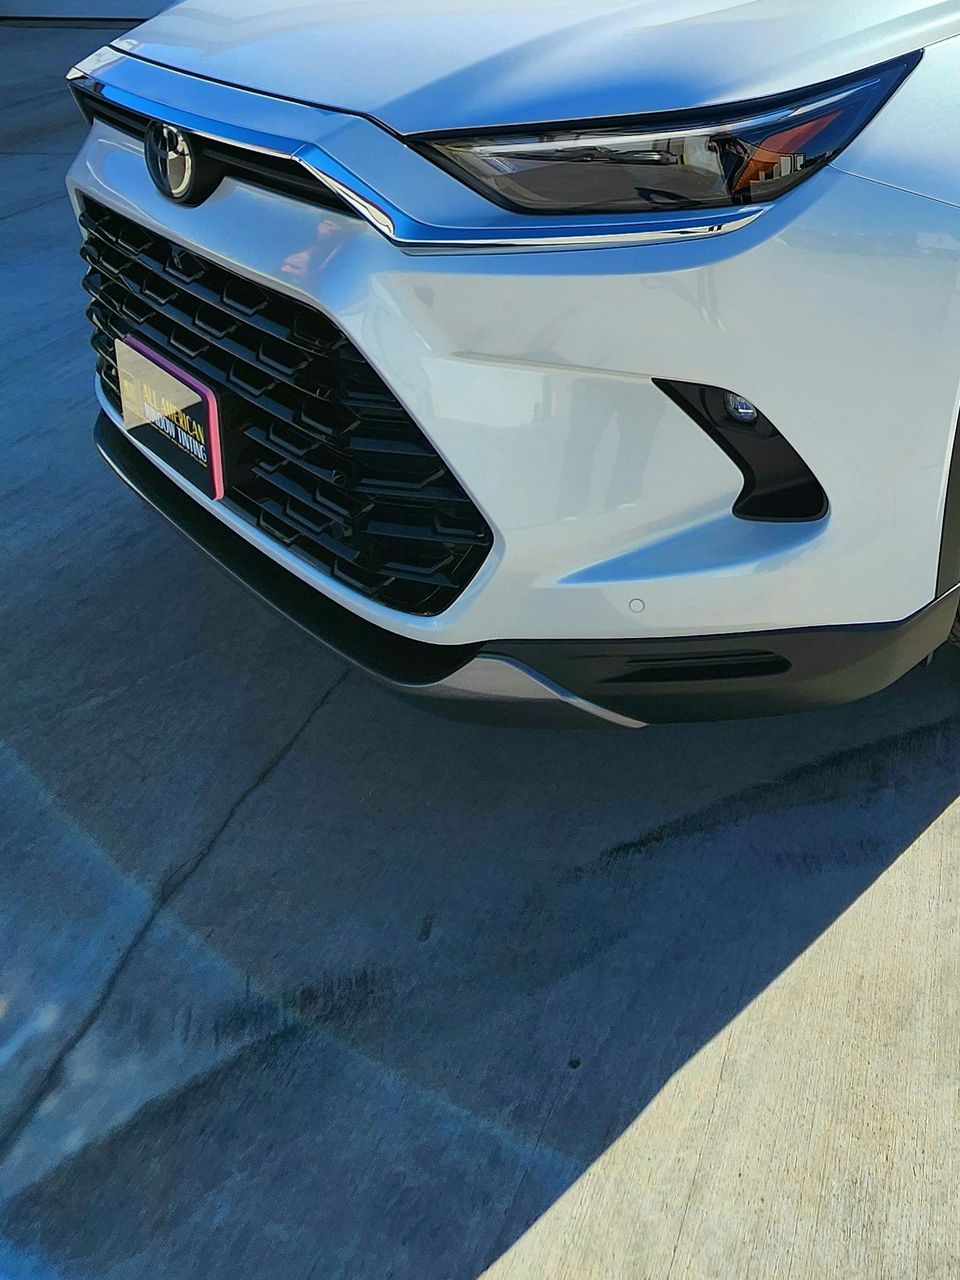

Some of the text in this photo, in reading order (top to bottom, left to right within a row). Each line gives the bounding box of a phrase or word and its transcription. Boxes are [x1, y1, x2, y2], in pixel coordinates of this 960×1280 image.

[143, 383, 157, 410] ALL
[161, 397, 205, 445] AMERICAN
[144, 401, 176, 439] WINDOW
[177, 428, 208, 463] TINTING
